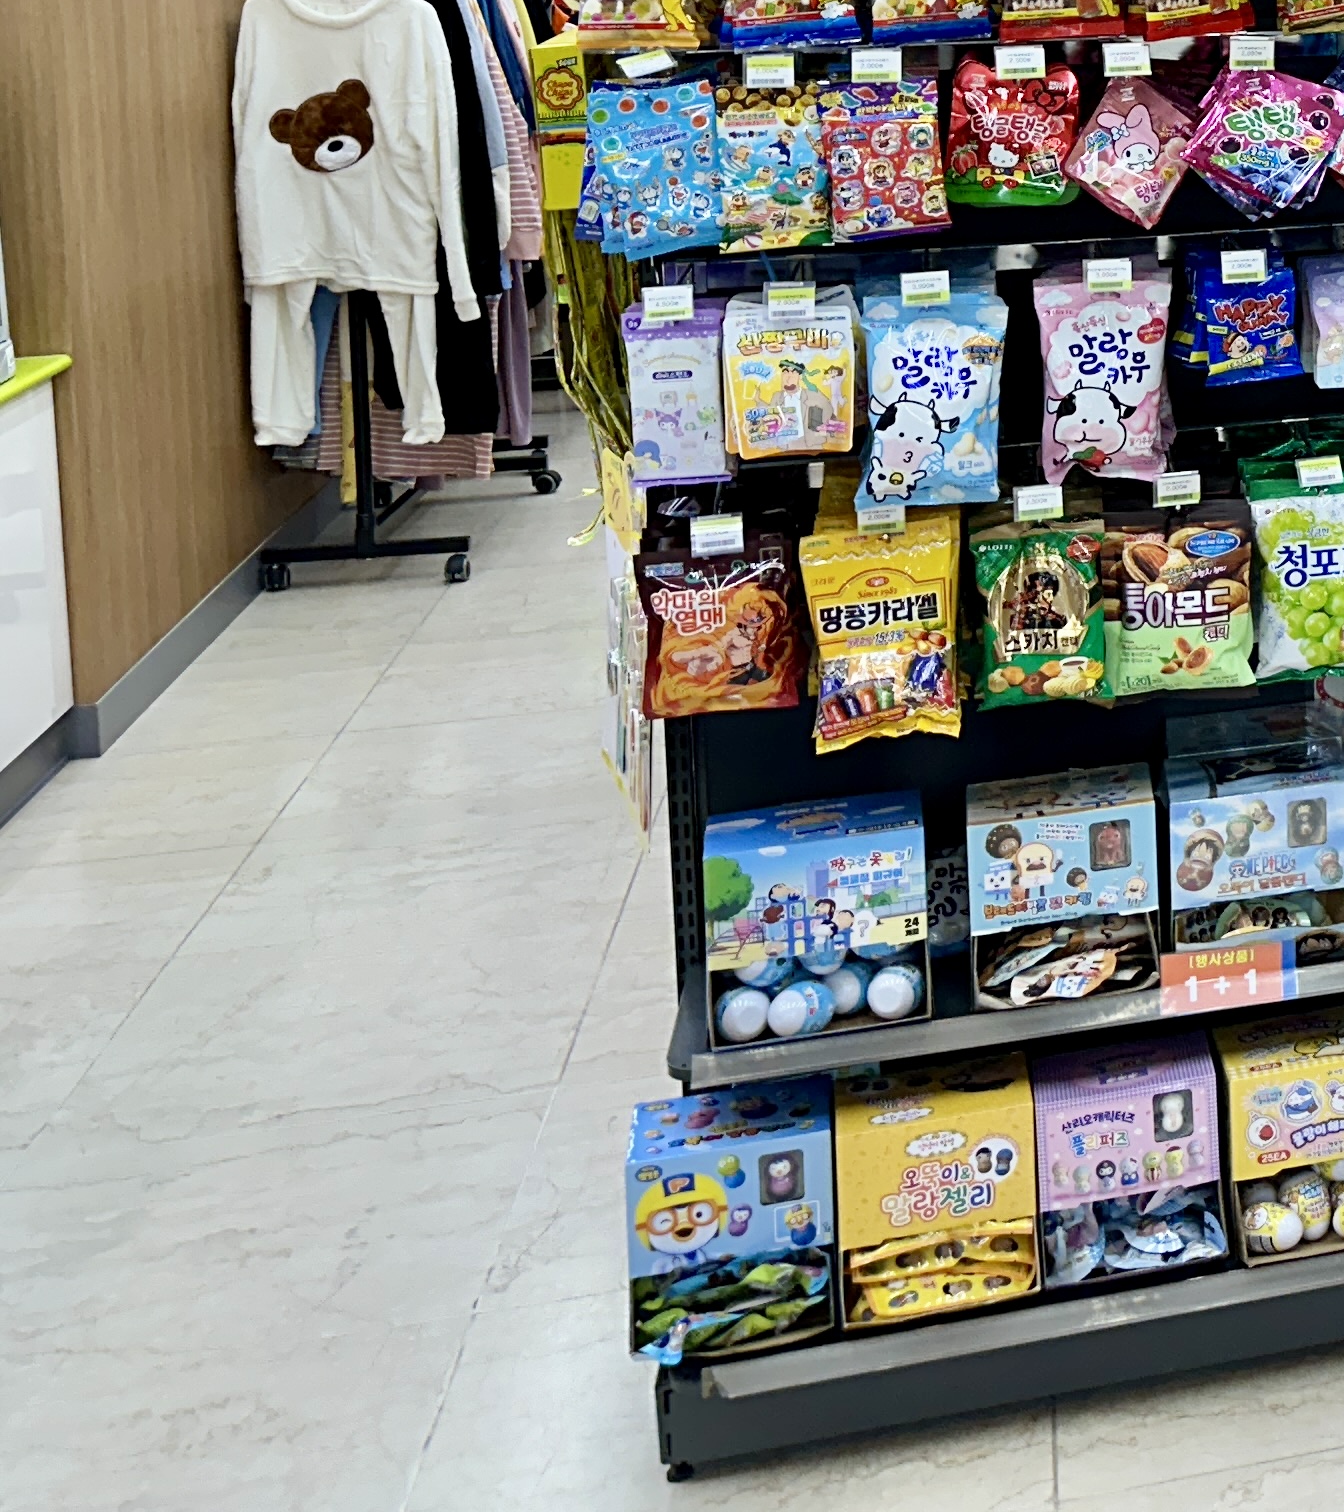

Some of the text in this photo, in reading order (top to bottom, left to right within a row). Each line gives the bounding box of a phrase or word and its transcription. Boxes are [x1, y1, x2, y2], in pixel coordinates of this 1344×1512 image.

[1068, 330, 1133, 376] 말랑
[1109, 350, 1151, 387] 카우
[651, 588, 723, 619] 악마의
[676, 604, 725, 635] 열매
[820, 592, 938, 634] 땅콩카라멜
[1122, 583, 1230, 631] 통아몬드
[904, 918, 920, 928] 24
[882, 1182, 994, 1227] 말랑젤리
